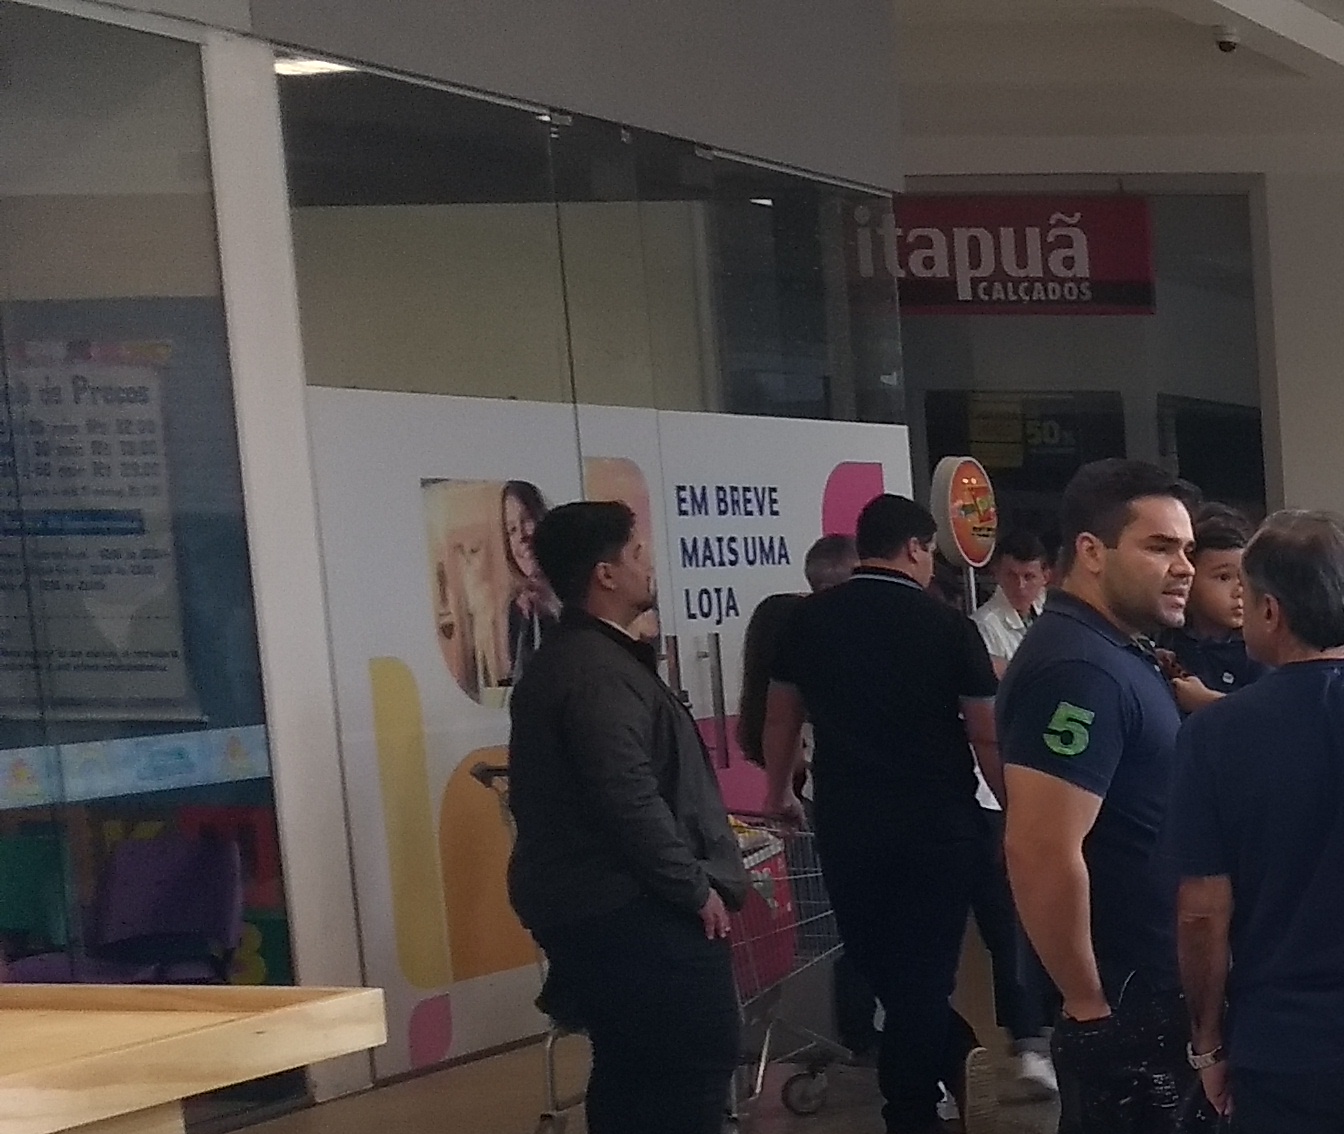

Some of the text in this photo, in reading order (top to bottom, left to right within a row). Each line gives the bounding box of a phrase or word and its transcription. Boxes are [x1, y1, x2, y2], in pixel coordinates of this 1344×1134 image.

[854, 205, 1091, 301] itapuã
[977, 281, 1094, 304] CALÇADOS
[676, 485, 780, 517] EM BREVE
[680, 535, 791, 569] MAIS UMA
[684, 586, 740, 626] LOJA
[1043, 701, 1095, 756] 5
